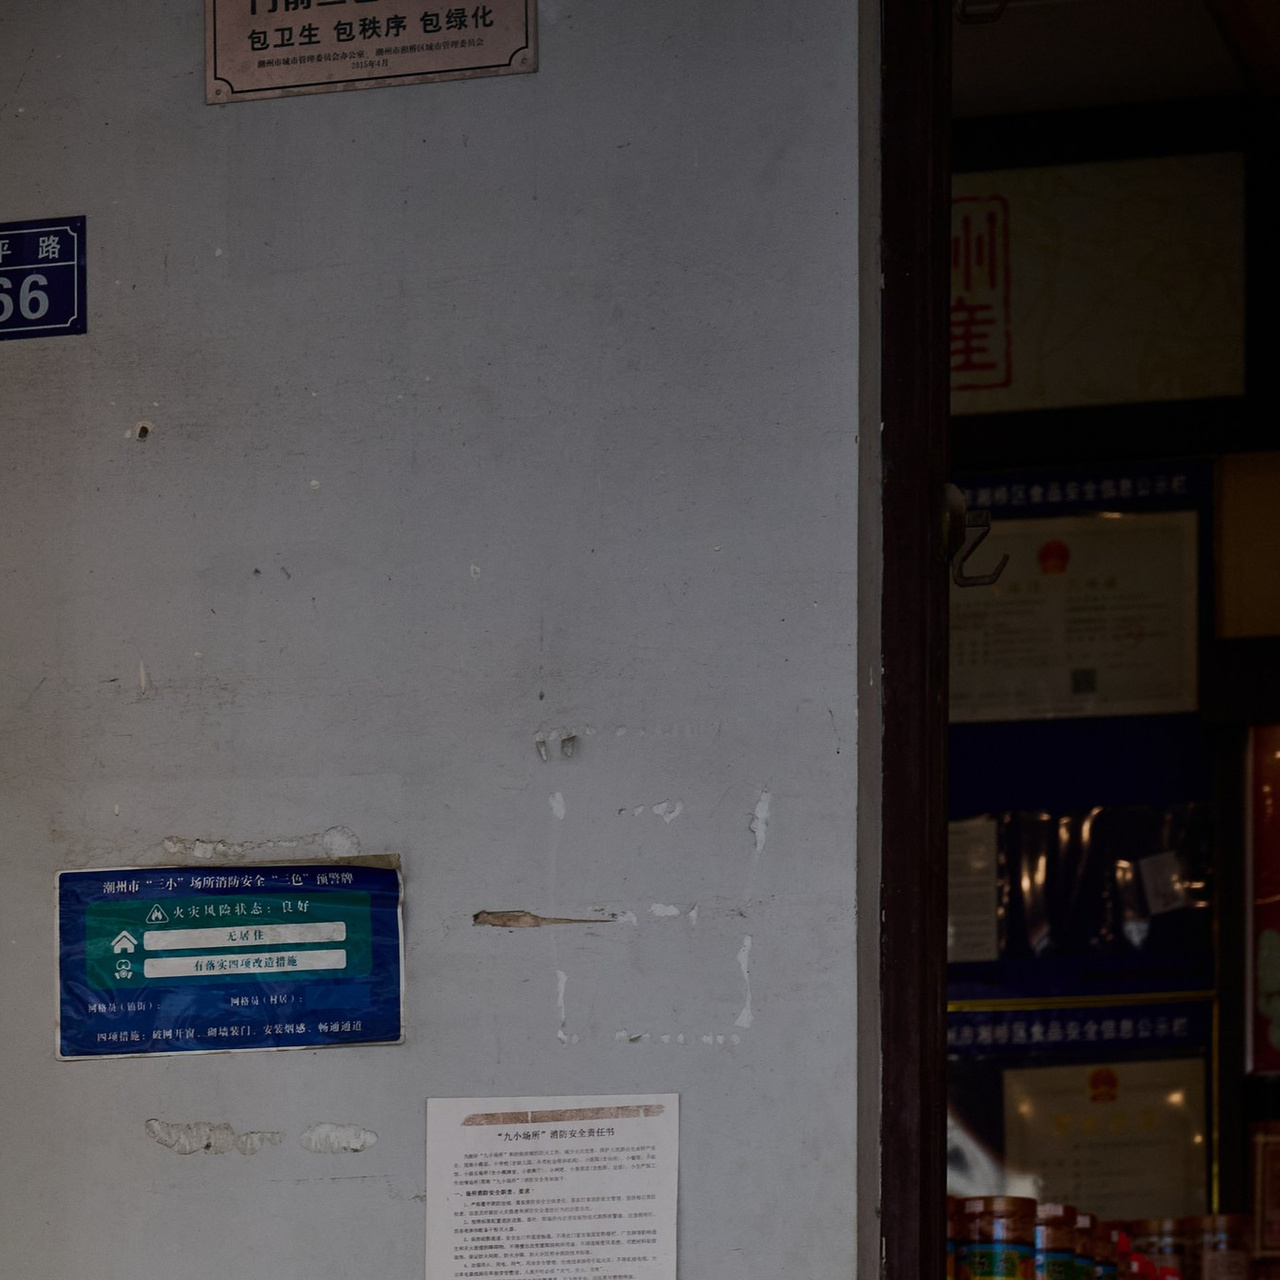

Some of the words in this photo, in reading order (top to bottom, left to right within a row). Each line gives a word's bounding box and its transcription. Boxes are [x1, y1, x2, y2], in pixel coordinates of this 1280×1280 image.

[248, 22, 321, 52] 包卫生
[333, 14, 408, 43] 包秩序
[420, 6, 495, 34] 包绿化
[226, 930, 265, 943] 无居住
[194, 955, 298, 972] 有落实四项改造措施
[497, 1127, 616, 1142] “九小场所”消防安全责任书
